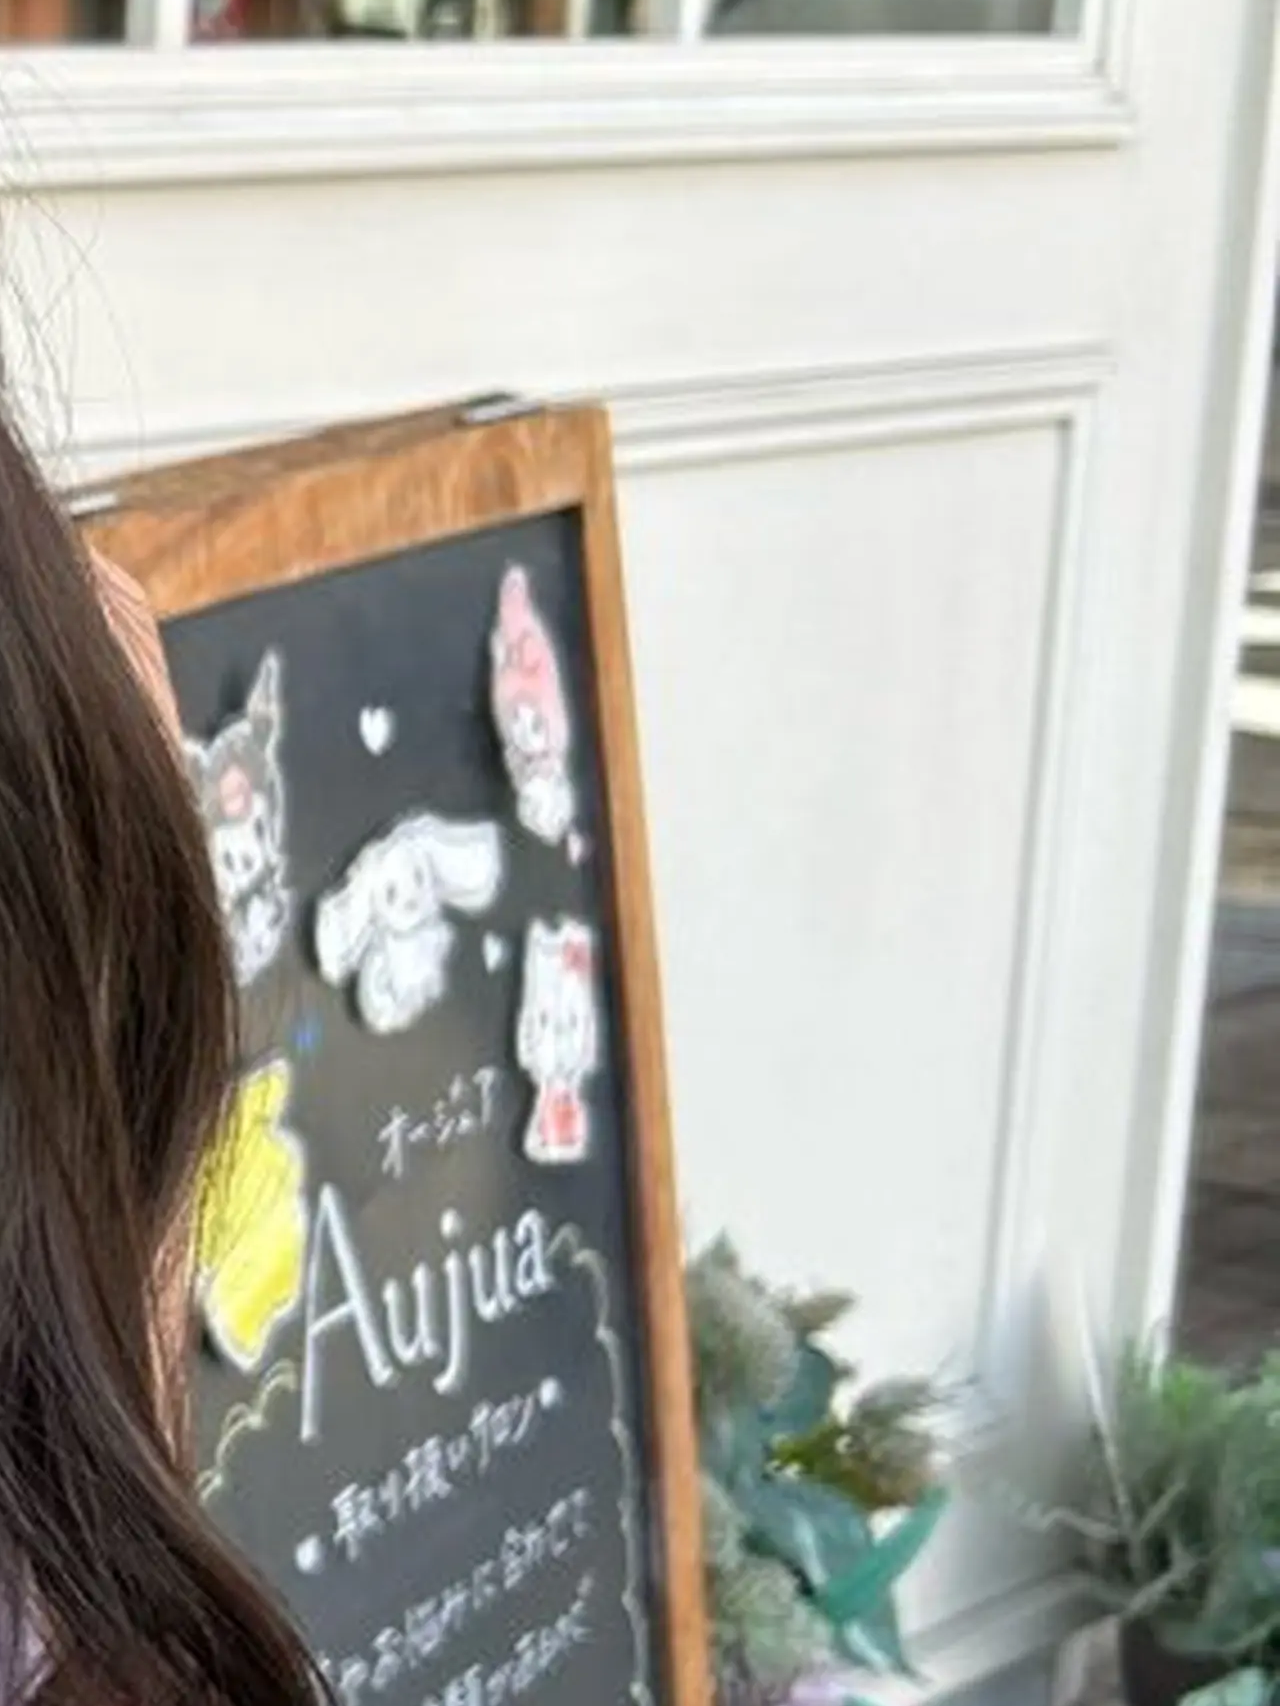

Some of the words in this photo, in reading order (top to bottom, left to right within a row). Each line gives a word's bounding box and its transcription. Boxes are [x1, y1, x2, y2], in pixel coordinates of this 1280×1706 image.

[378, 1066, 496, 1179] オージュア
[300, 1183, 552, 1443] Aujua
